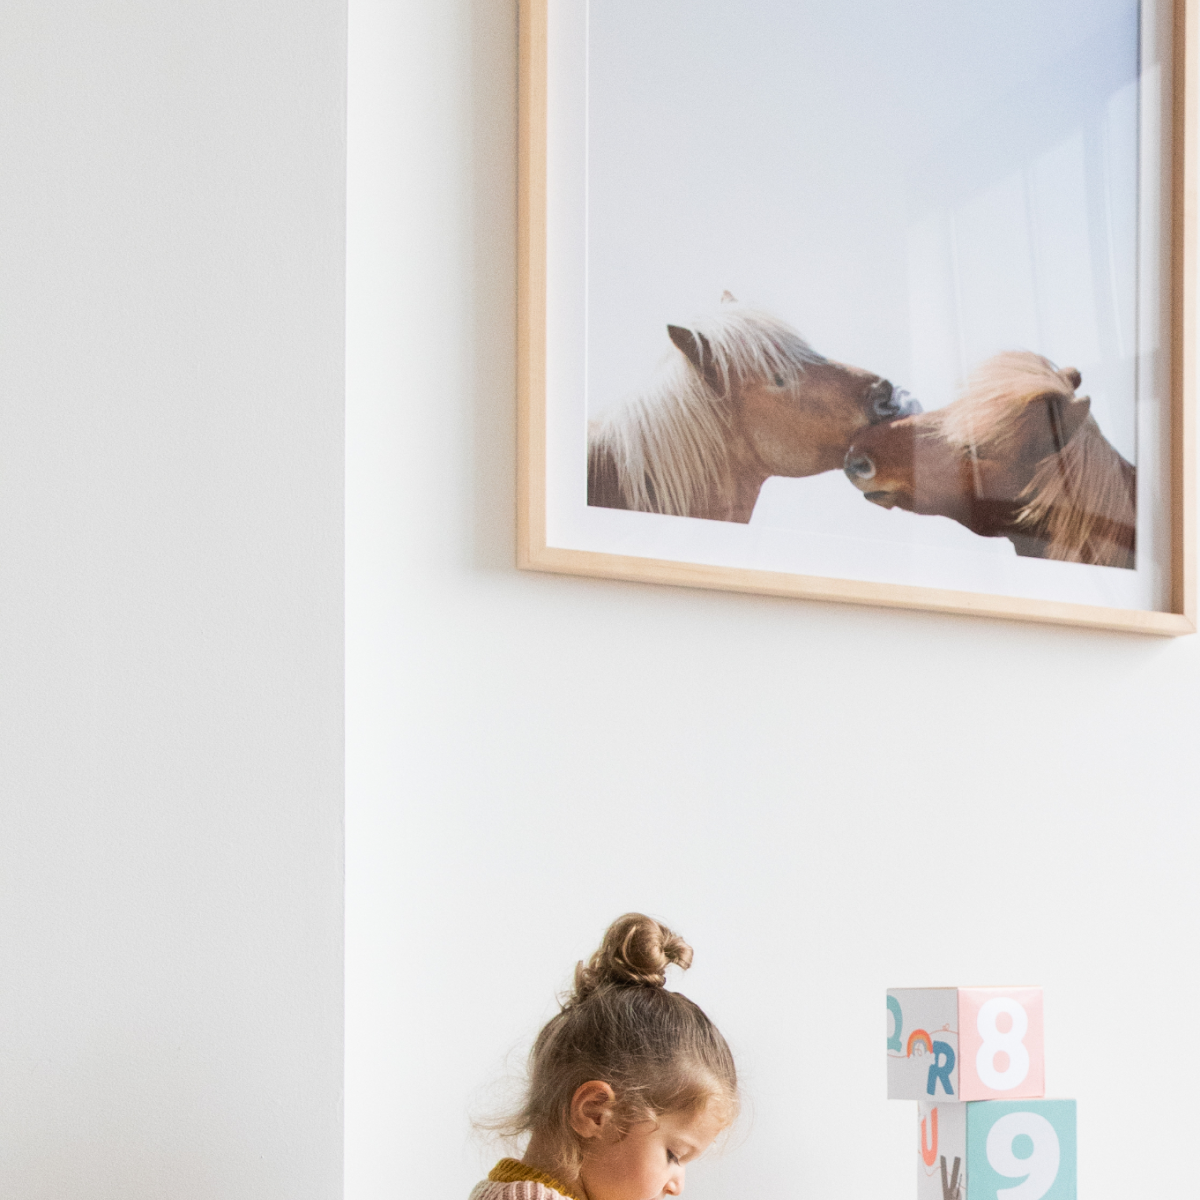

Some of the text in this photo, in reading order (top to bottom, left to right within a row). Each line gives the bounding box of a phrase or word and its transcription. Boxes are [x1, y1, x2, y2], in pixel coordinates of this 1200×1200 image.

[927, 1040, 956, 1096] R
[976, 997, 1030, 1091] 8
[921, 1107, 938, 1167] U
